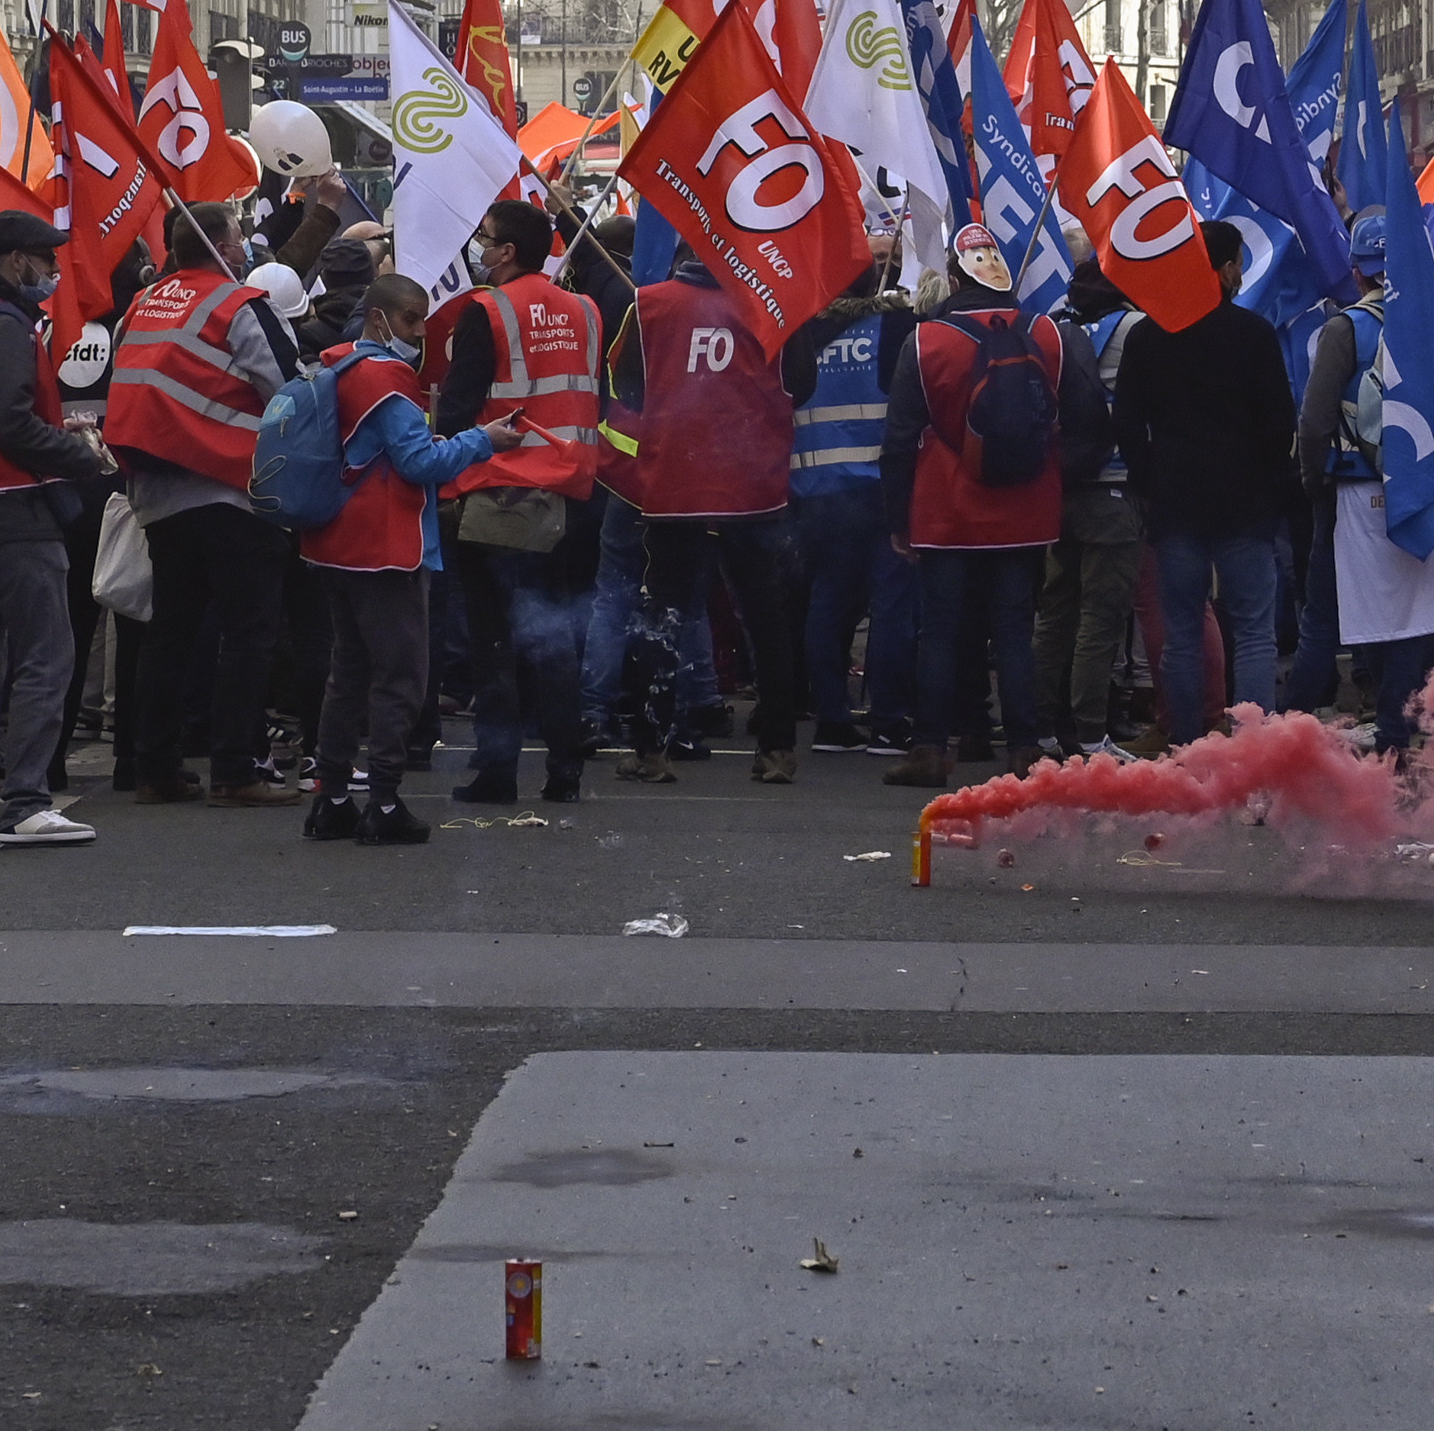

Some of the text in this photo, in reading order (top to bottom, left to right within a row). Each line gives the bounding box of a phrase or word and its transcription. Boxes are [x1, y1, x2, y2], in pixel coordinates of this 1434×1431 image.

[281, 30, 306, 44] BUS
[273, 80, 286, 90] 22
[575, 82, 590, 91] BUS
[696, 88, 825, 233] FO
[1085, 134, 1195, 261] FO
[655, 158, 787, 330] Transports et logistique
[757, 240, 793, 280] UNCP
[529, 303, 547, 328] FO
[687, 327, 735, 373] FO
